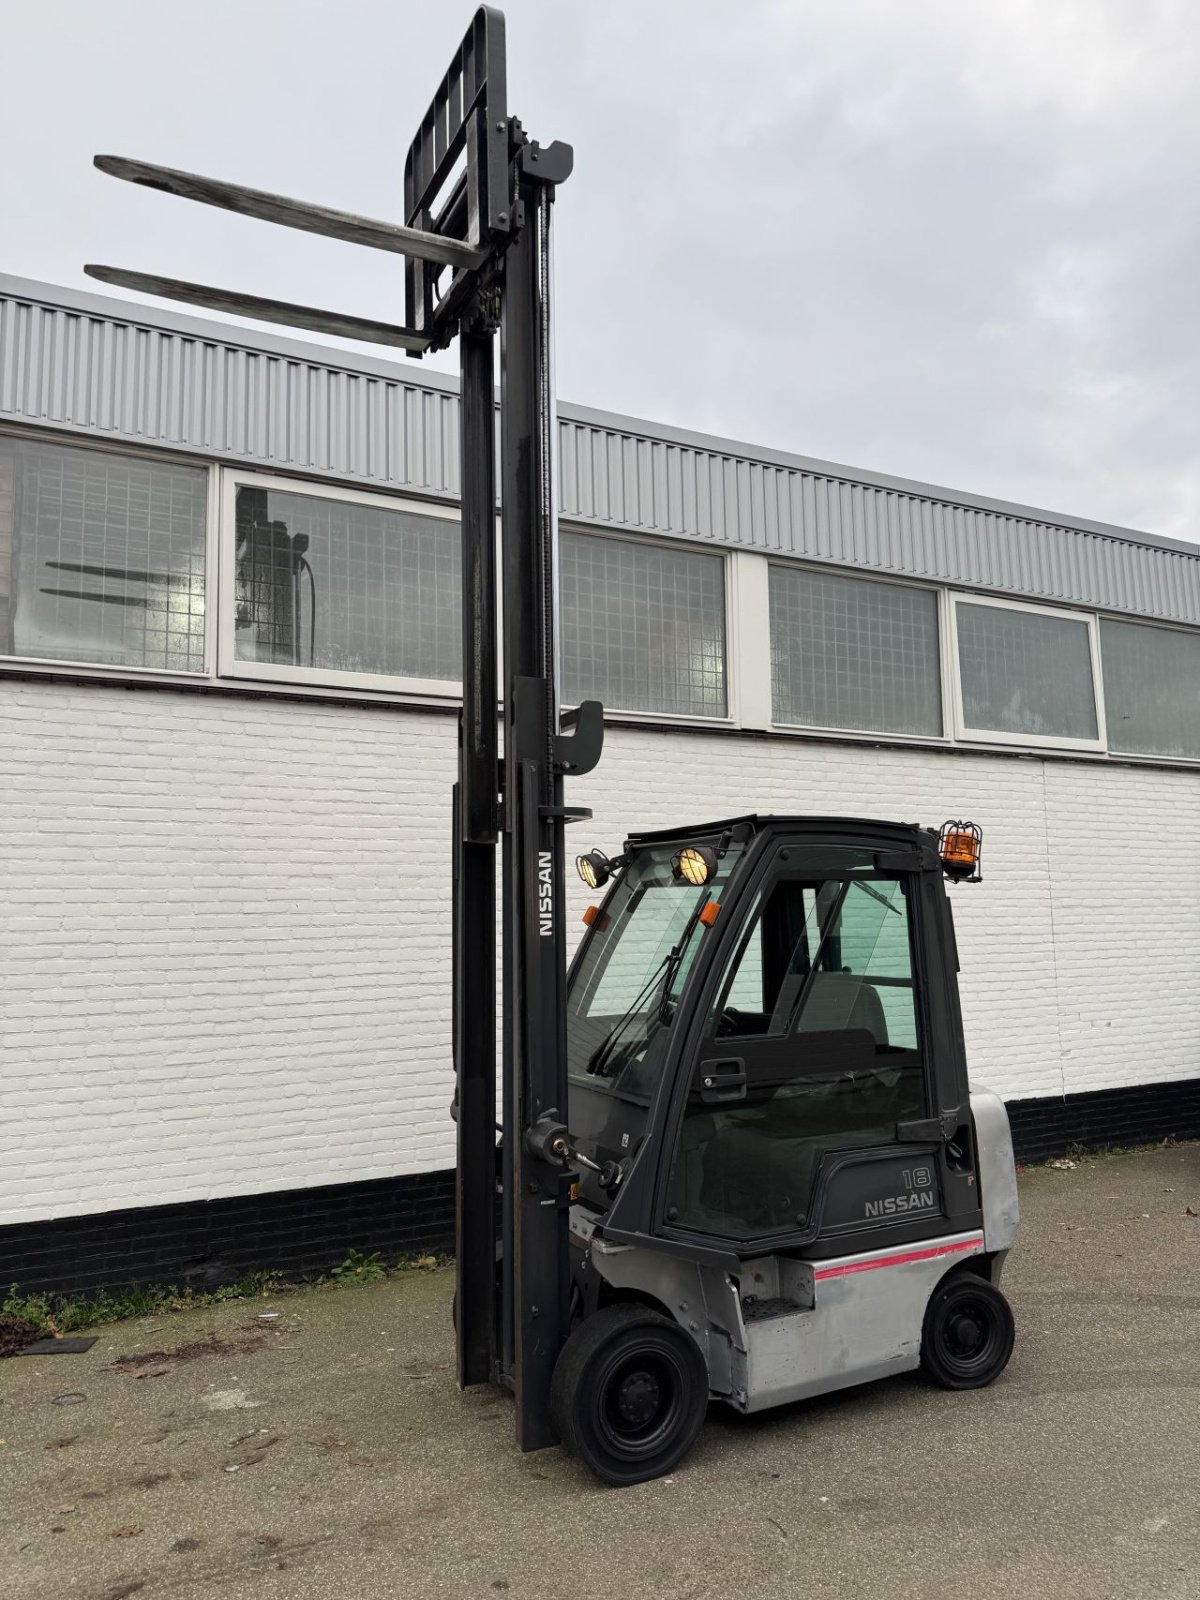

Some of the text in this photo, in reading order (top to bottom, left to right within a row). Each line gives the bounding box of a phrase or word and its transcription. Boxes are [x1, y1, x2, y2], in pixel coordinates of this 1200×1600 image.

[538, 851, 553, 936] NISSAN
[902, 1167, 931, 1190] 18
[864, 1191, 934, 1217] NISSAN
